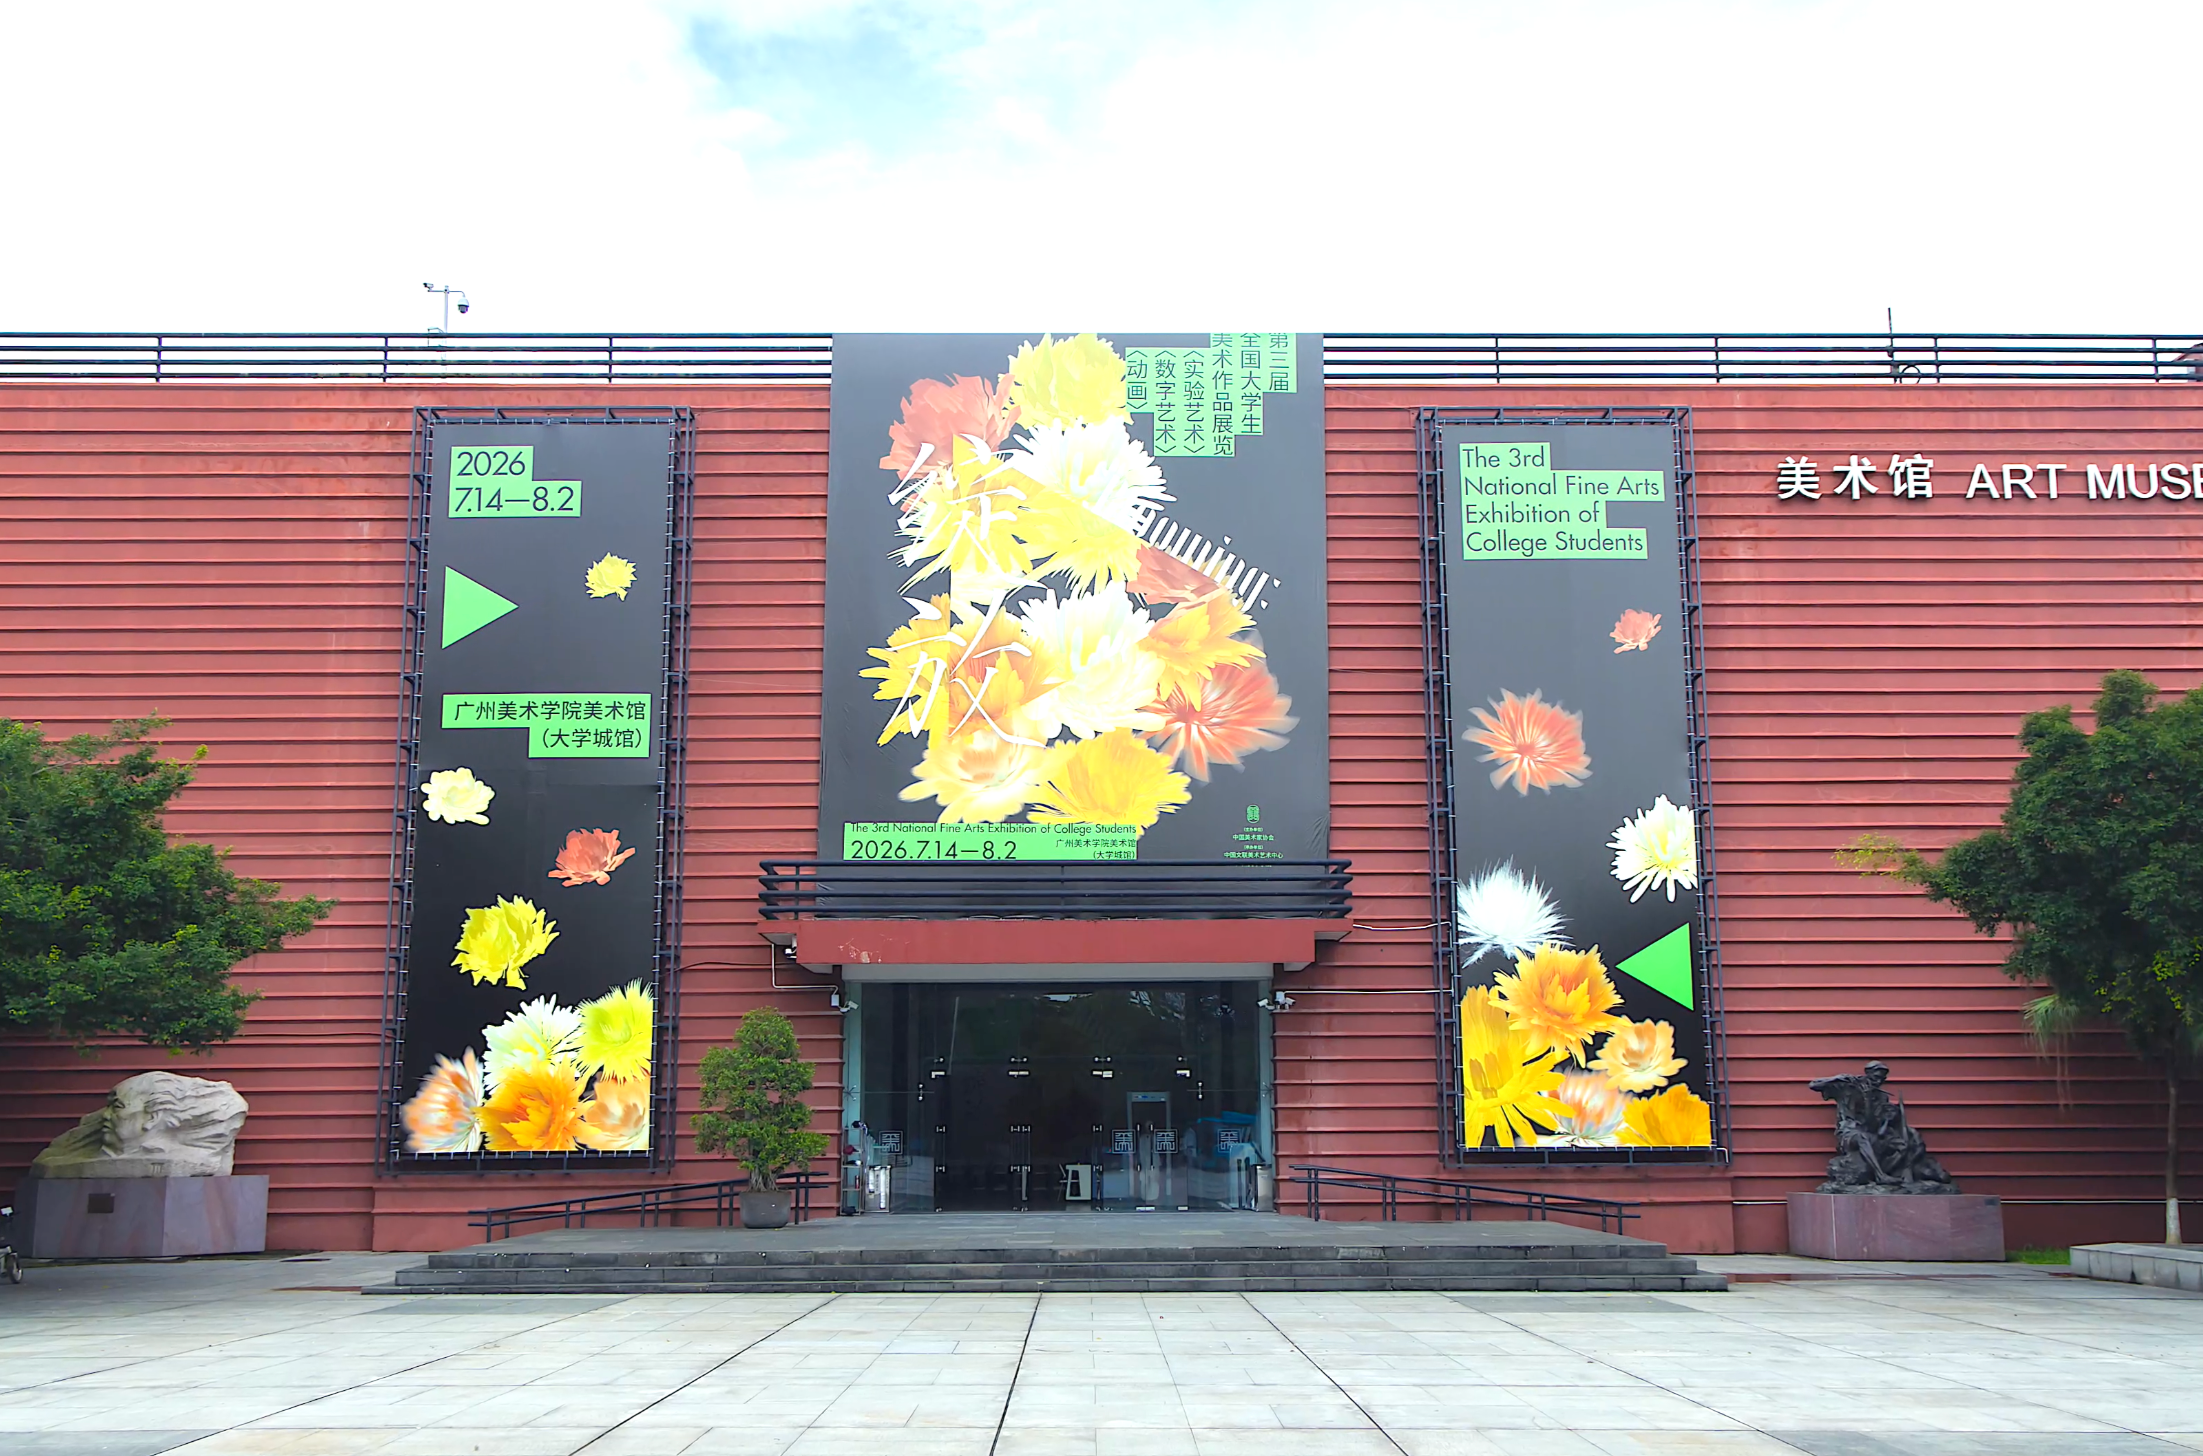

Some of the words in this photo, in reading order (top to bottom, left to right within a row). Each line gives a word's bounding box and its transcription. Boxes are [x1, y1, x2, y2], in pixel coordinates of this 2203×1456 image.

[1240, 333, 1262, 434] 全国大学生
[456, 451, 526, 476] 2026
[1462, 446, 1500, 468] The
[1509, 445, 1545, 468] 3rd
[1465, 473, 1557, 496] National
[1566, 475, 1609, 495] Fine
[1617, 475, 1660, 495] Arts
[1776, 453, 1934, 500] 美术馆
[1965, 463, 2067, 500] ART
[1466, 500, 1570, 524] Exhibition
[1578, 500, 1600, 523] of
[1466, 529, 1547, 557] College
[1555, 529, 1644, 551] Students
[454, 700, 647, 721] 广州美术学院美术馆
[542, 728, 643, 749] （大学城馆）
[851, 823, 868, 832] The
[872, 823, 889, 832] 3rd
[893, 823, 936, 832] National
[940, 823, 961, 832] Fine
[964, 823, 985, 833] Arts
[988, 823, 1037, 834] Exhibition
[1040, 823, 1051, 834] of
[1054, 823, 1091, 836] College
[1095, 823, 1136, 834] Students
[1056, 839, 1136, 848] 广州美术学院美术馆
